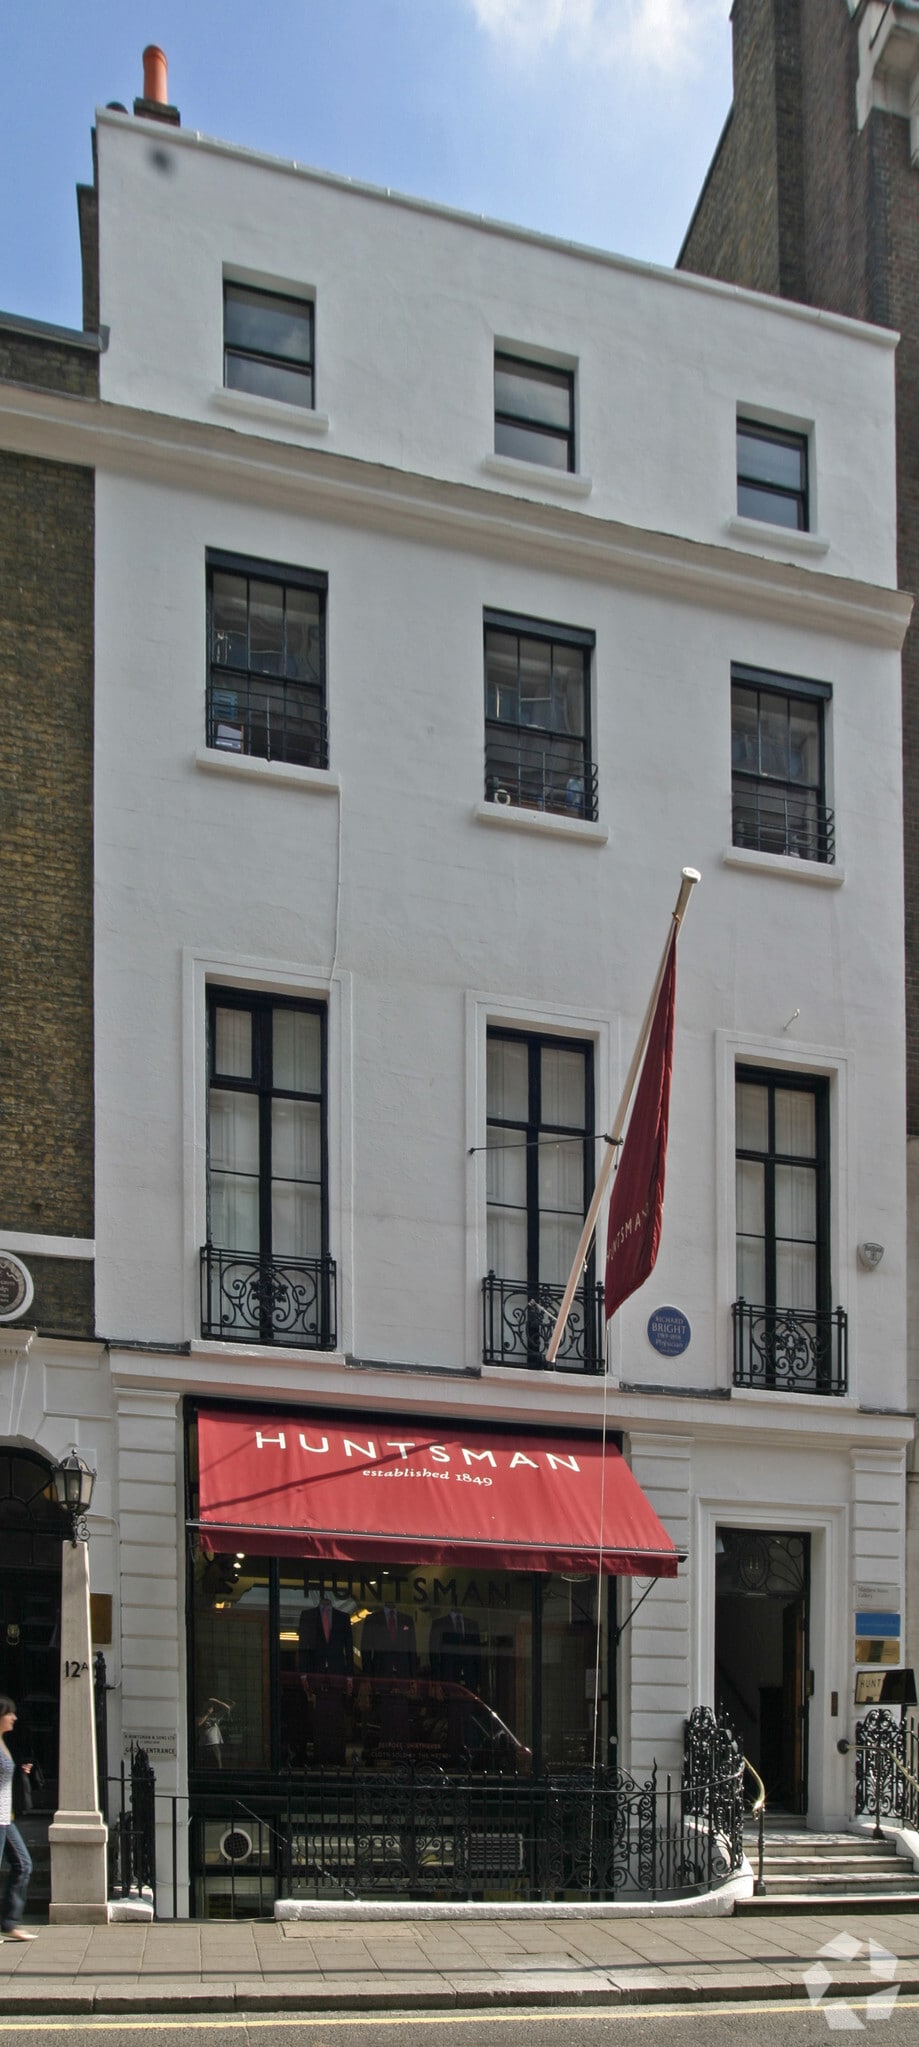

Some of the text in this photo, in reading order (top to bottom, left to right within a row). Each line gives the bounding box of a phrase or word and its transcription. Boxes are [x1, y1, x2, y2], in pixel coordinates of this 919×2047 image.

[652, 1322, 686, 1335] BRIGHT
[255, 1431, 581, 1473] HUNTSMAN
[362, 1468, 493, 1487] established 1849
[303, 1570, 511, 1608] HUNTSMAN
